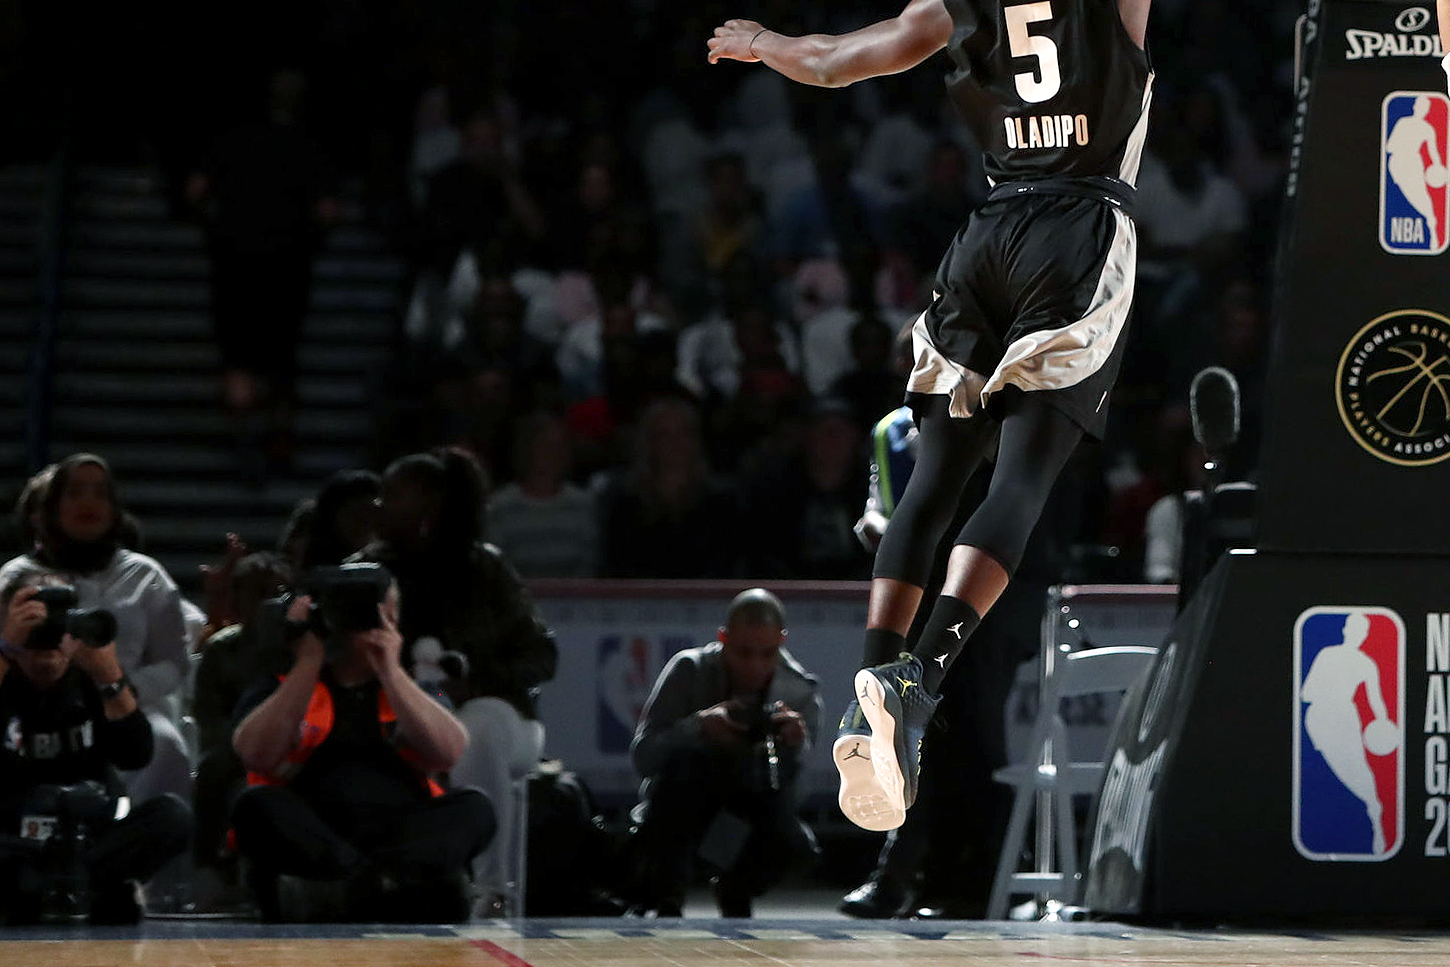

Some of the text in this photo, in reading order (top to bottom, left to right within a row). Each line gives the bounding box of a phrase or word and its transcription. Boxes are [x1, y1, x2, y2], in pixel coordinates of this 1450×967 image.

[1004, 0, 1061, 103] 5
[1003, 113, 1090, 150] OLADIPO
[1390, 217, 1425, 244] NBA
[1348, 326, 1400, 386] NATIONAL
[1349, 391, 1391, 447] PLAYERS
